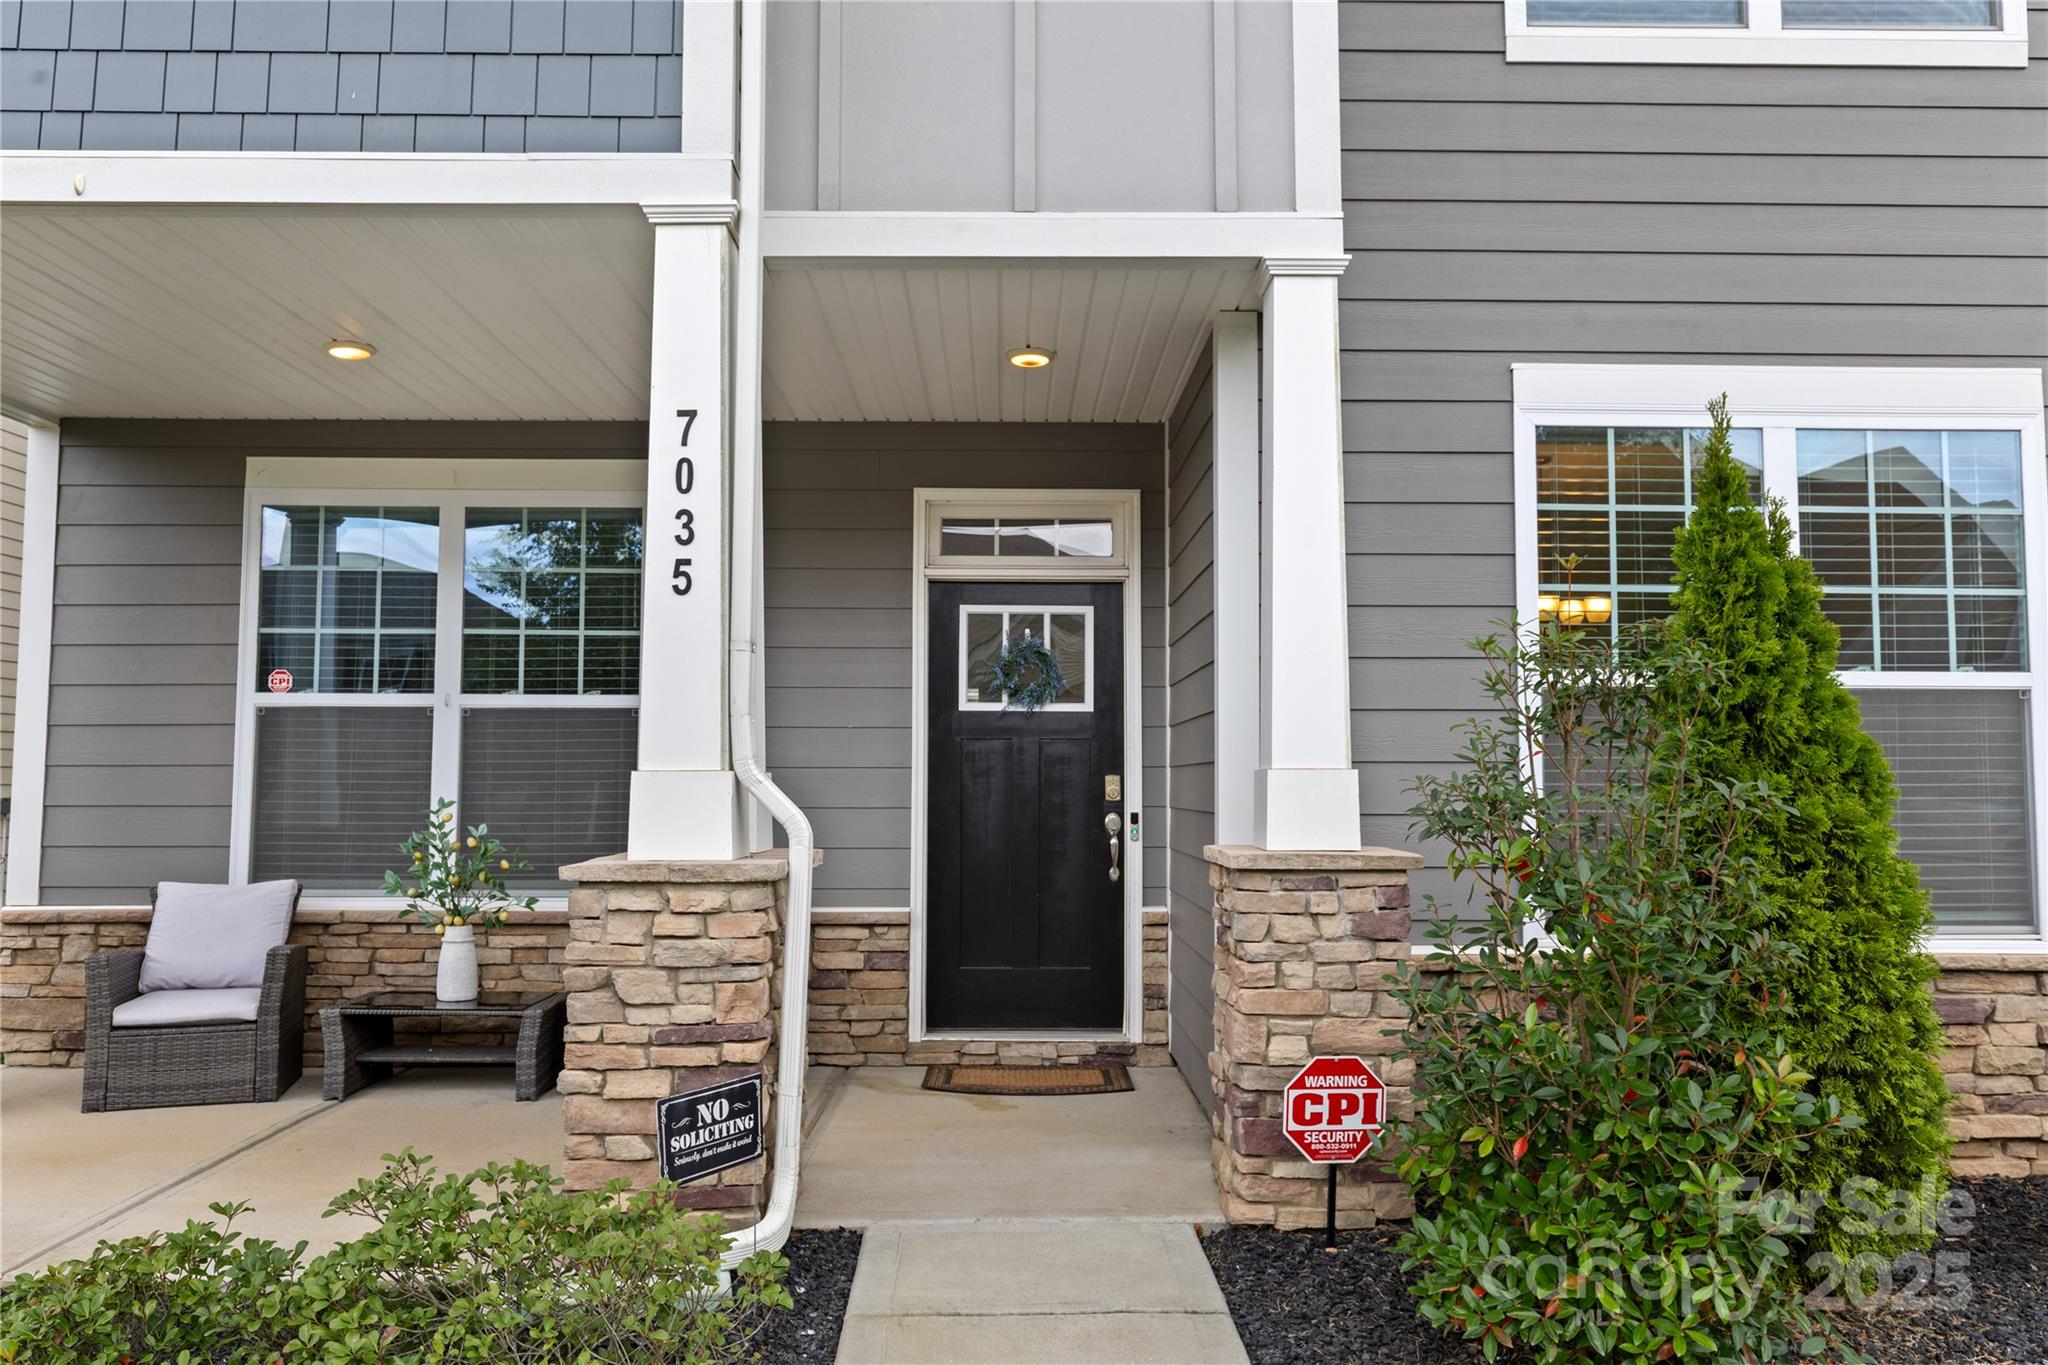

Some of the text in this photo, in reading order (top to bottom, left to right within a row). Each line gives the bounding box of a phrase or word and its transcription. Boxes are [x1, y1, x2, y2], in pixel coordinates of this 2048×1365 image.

[672, 409, 698, 596] 7035
[271, 677, 290, 685] CPI
[1304, 1075, 1368, 1088] WARNING
[696, 1098, 729, 1127] NO
[1292, 1093, 1378, 1126] CPI
[670, 1114, 754, 1153] SOLICITING
[1304, 1131, 1363, 1143] SECURITY
[717, 1142, 731, 1153] make
